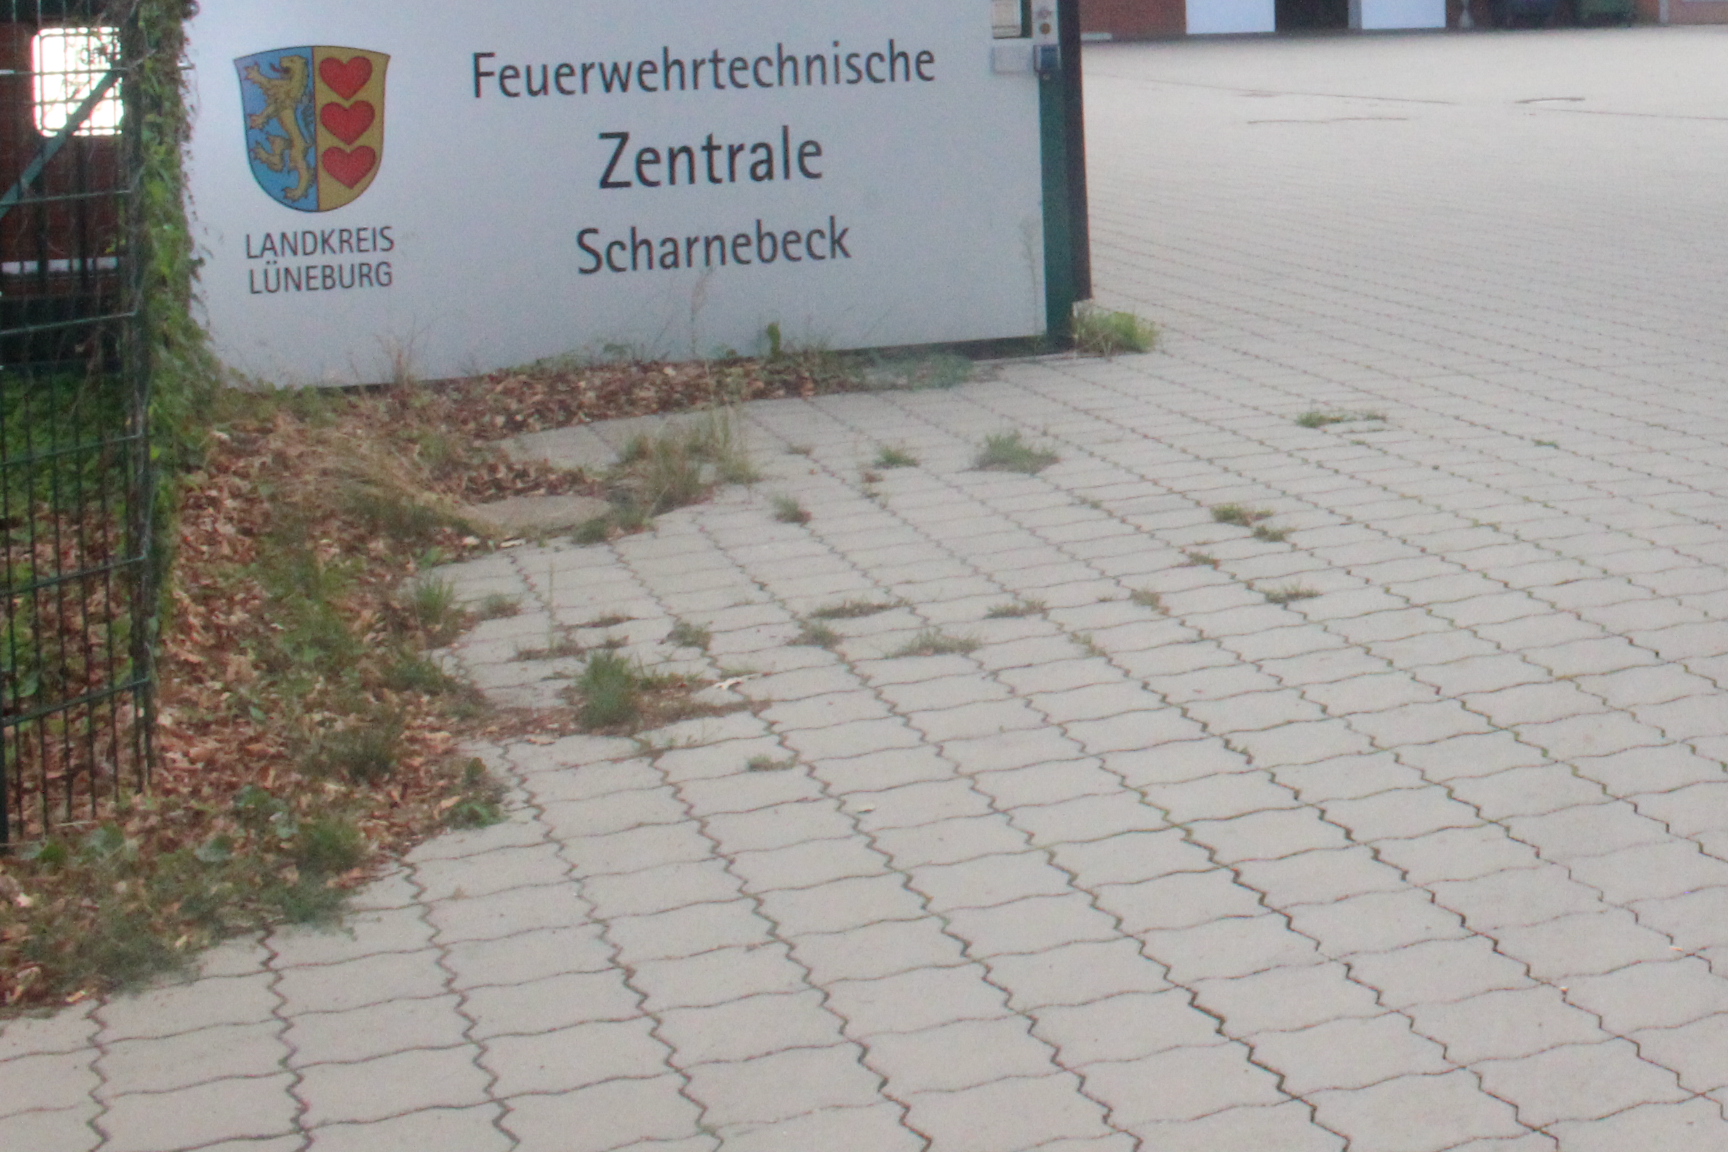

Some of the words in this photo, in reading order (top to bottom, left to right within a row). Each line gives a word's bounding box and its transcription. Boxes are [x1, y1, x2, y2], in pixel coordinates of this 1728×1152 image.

[473, 38, 936, 99] Feuerwehrtechnische
[598, 125, 823, 189] Zentrale
[246, 226, 395, 259] LANDKREIS
[576, 215, 852, 276] Scharnebeck
[249, 260, 393, 295] LÜNEBURG
